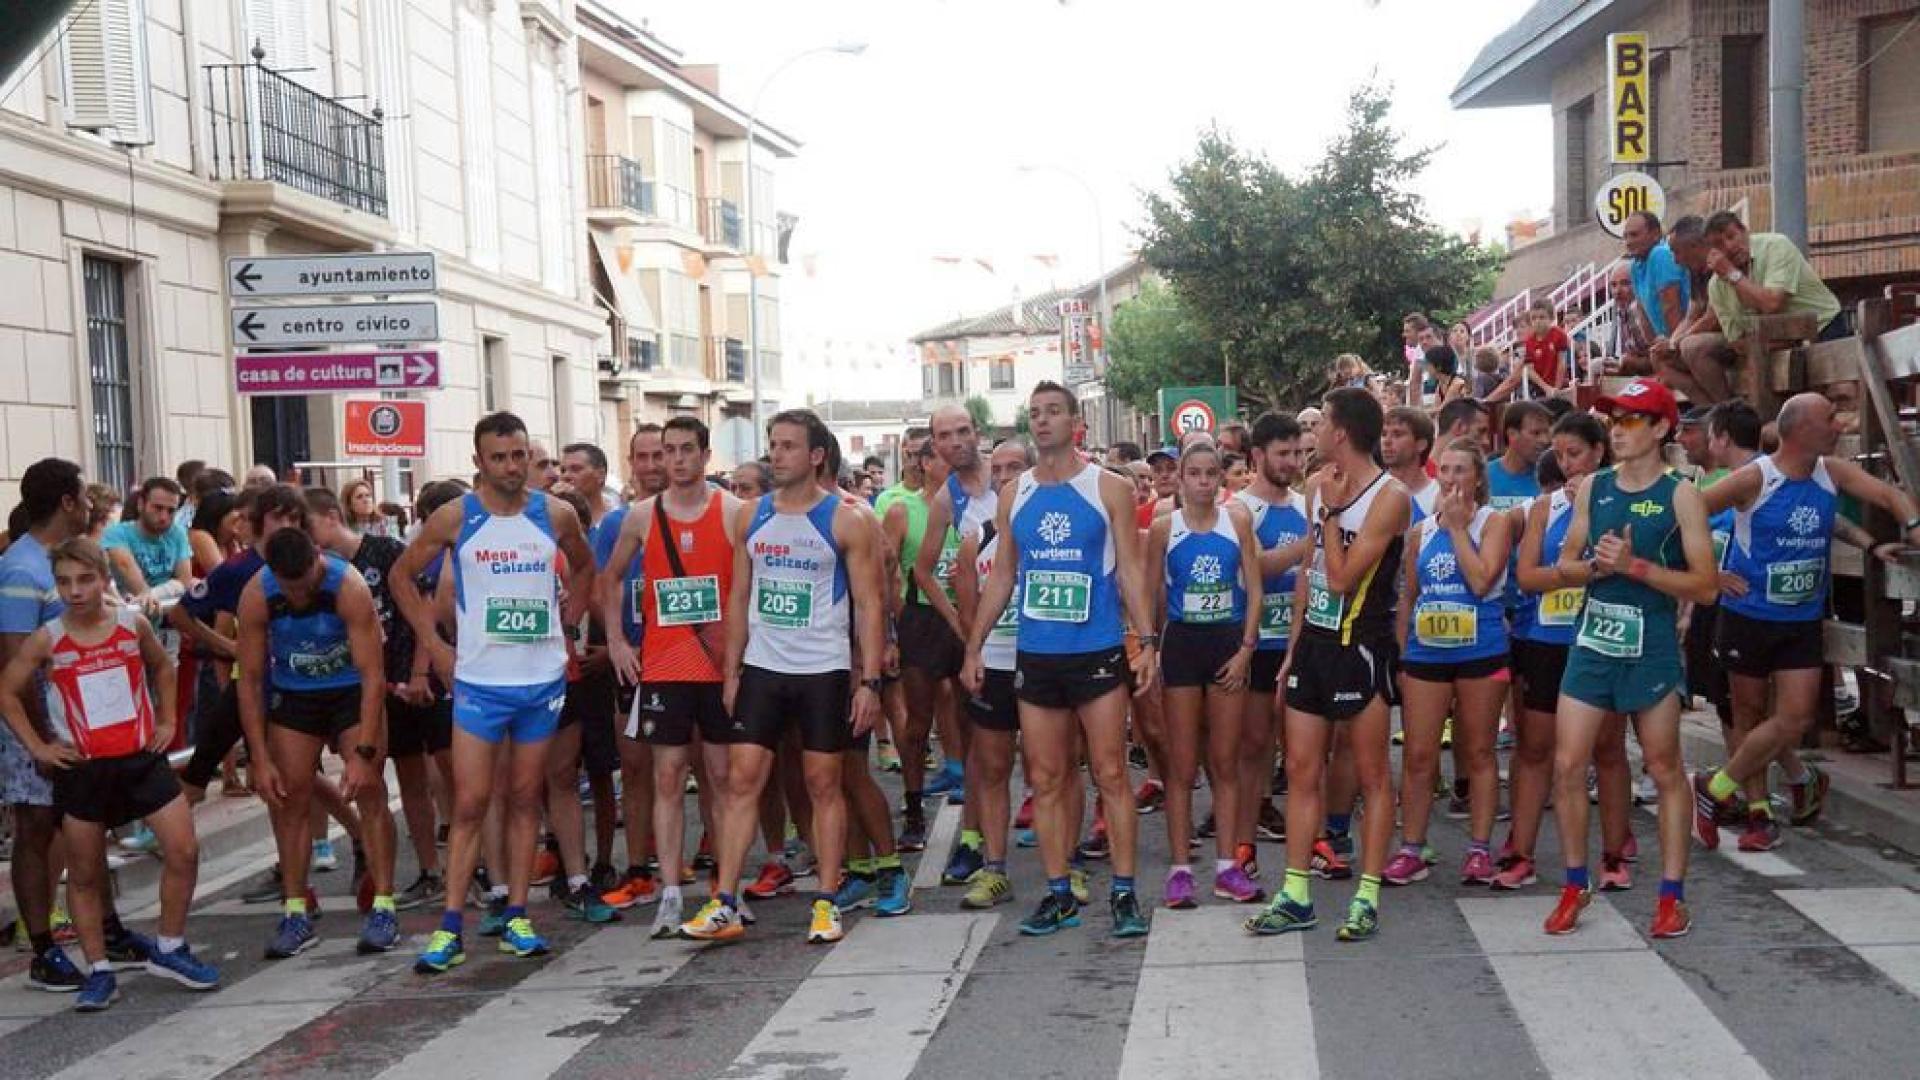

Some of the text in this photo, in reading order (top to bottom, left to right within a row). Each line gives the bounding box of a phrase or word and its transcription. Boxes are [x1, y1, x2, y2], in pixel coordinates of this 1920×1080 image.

[1617, 43, 1644, 154] BAR
[299, 266, 430, 287] ayuntamiento
[282, 318, 344, 334] centro
[240, 363, 373, 383] casa de cultura
[1182, 414, 1205, 432] 50
[475, 549, 518, 563] Mega
[667, 590, 703, 612] 231
[763, 592, 798, 614] 205
[1038, 586, 1074, 608] 211
[1201, 594, 1221, 610] 22
[496, 610, 537, 631] 204
[1426, 615, 1459, 635] 101
[1593, 617, 1625, 641] 222
